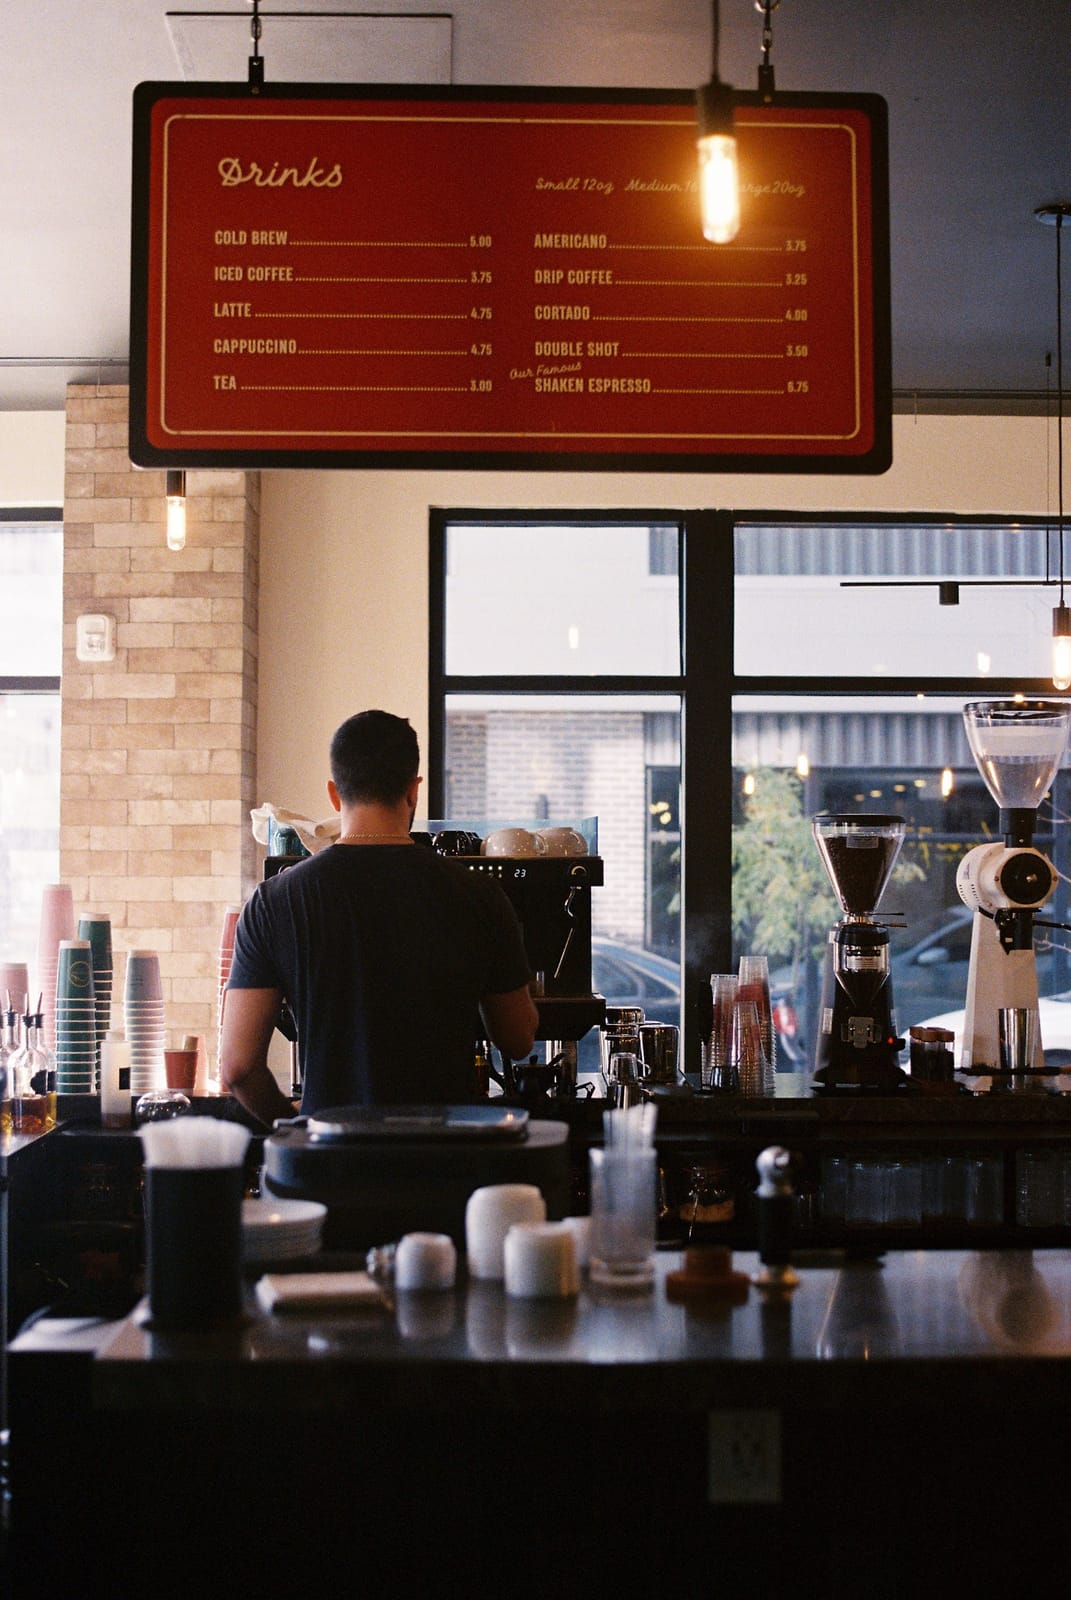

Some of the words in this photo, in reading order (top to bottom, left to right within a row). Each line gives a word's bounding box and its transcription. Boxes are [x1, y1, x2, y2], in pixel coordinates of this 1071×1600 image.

[218, 157, 342, 187] Drinks
[535, 176, 580, 191] Small
[624, 178, 682, 192] Medium
[215, 230, 247, 245] COLD
[252, 231, 287, 246] BREW
[470, 235, 491, 248] 5.00
[534, 234, 606, 249] AMERICANO
[786, 240, 806, 252] 3.75
[215, 267, 243, 281] ICED
[248, 267, 293, 282] COFFEE
[471, 271, 492, 284] 3.75
[535, 270, 563, 285] DRIP
[568, 270, 612, 285] COFFEE
[786, 273, 807, 286] 3.25
[215, 303, 251, 318] LATTE
[471, 307, 492, 320] 4.75
[535, 306, 589, 321] CORTADO
[785, 309, 807, 322] 4.00
[214, 339, 296, 354] CAPPUCCINO
[471, 344, 492, 356] 4.75
[535, 342, 583, 357] DOUBLE
[588, 342, 619, 357] SHOT
[786, 345, 808, 358] 3.50
[510, 368, 534, 380] Our
[537, 362, 581, 377] Famous
[214, 376, 236, 390] TEA
[470, 380, 492, 393] 3.00
[535, 378, 583, 393] SHAKEN
[589, 378, 650, 393] ESPRESSO
[513, 868, 527, 878] 23
